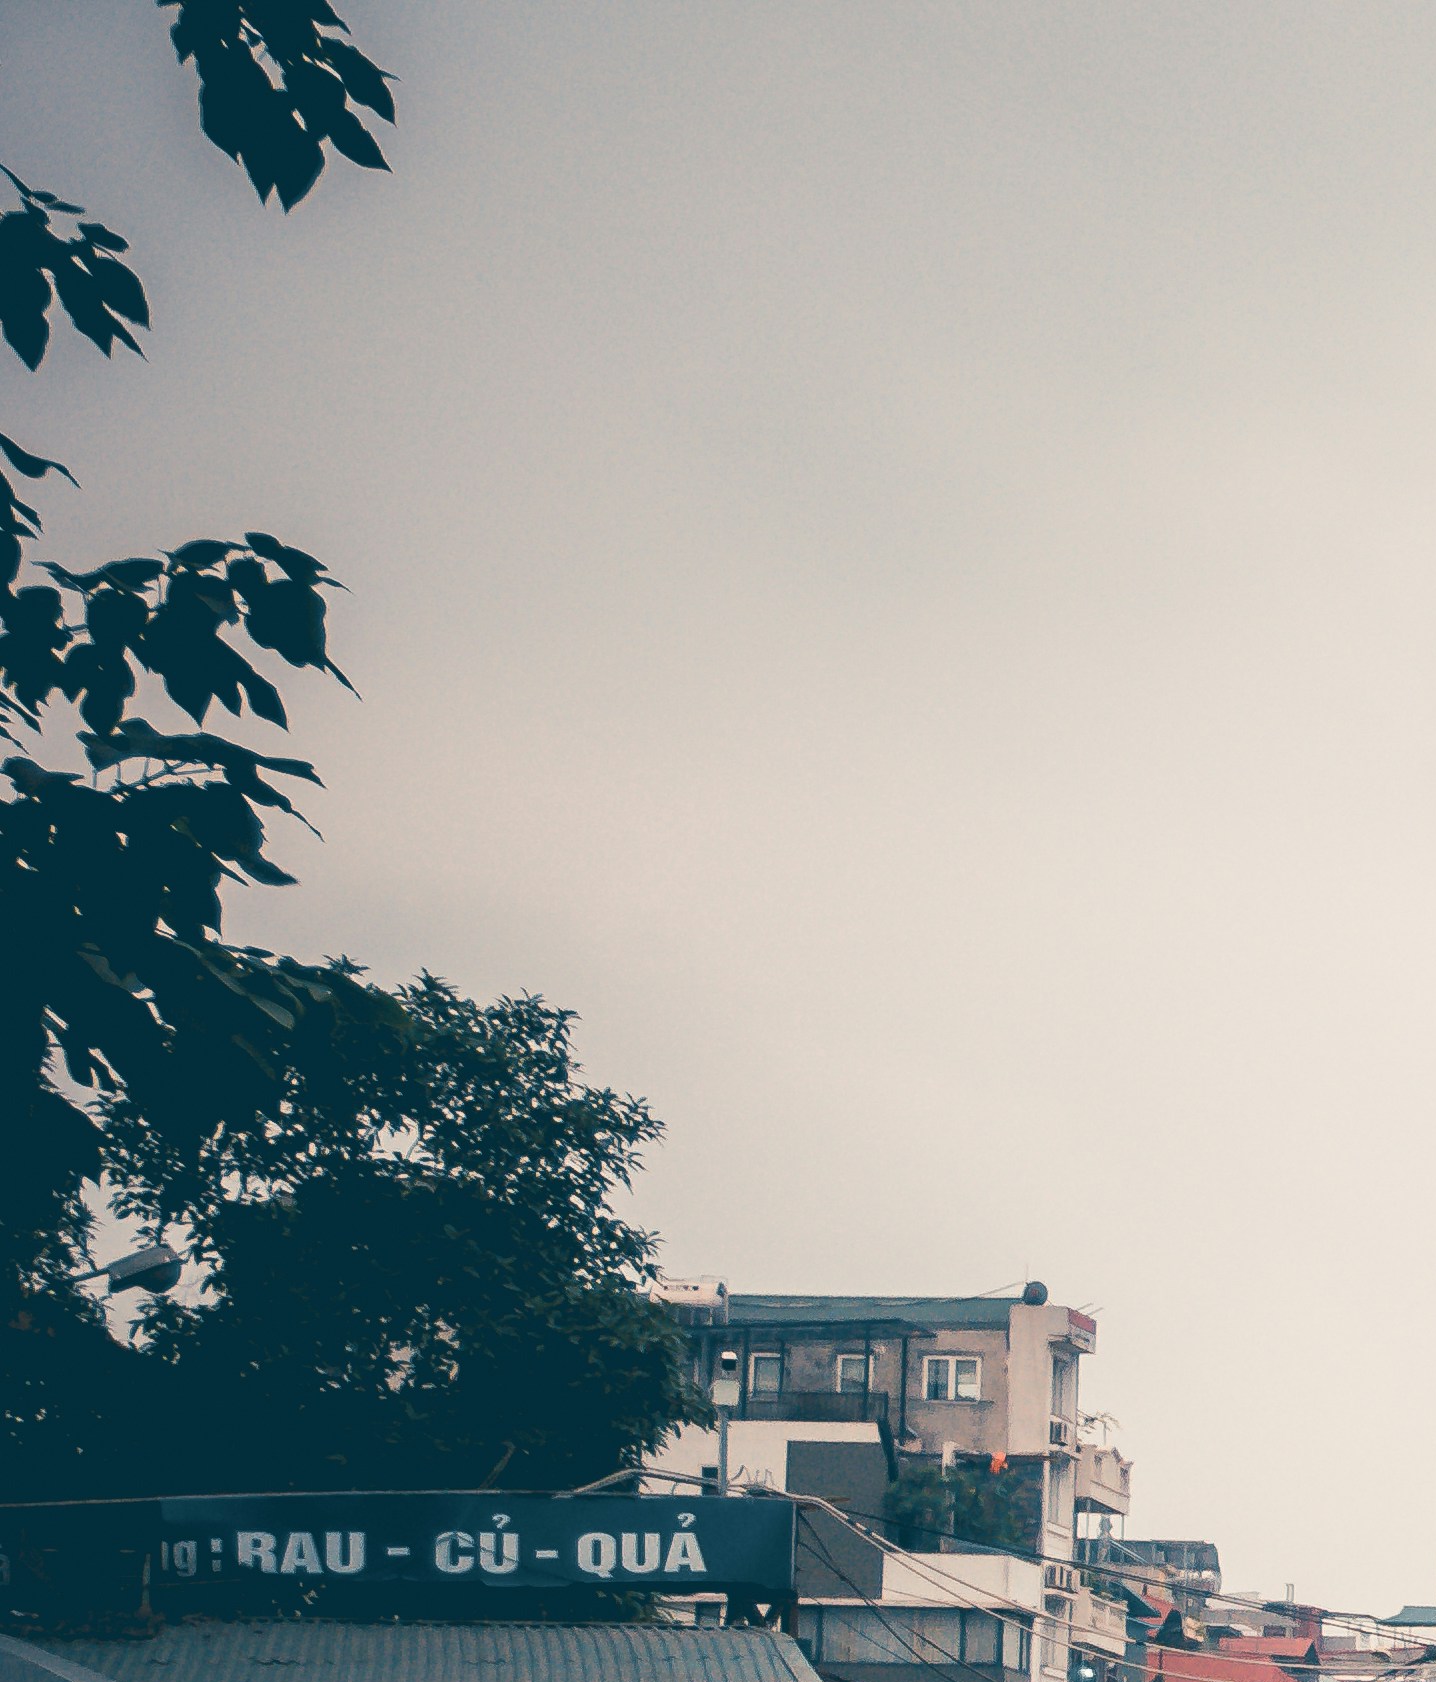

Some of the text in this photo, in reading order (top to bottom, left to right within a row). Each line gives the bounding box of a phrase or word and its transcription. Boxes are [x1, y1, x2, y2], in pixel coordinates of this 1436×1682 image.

[236, 1531, 366, 1574] RAU
[434, 1513, 520, 1574] CỦ
[577, 1512, 708, 1578] QUẢ
